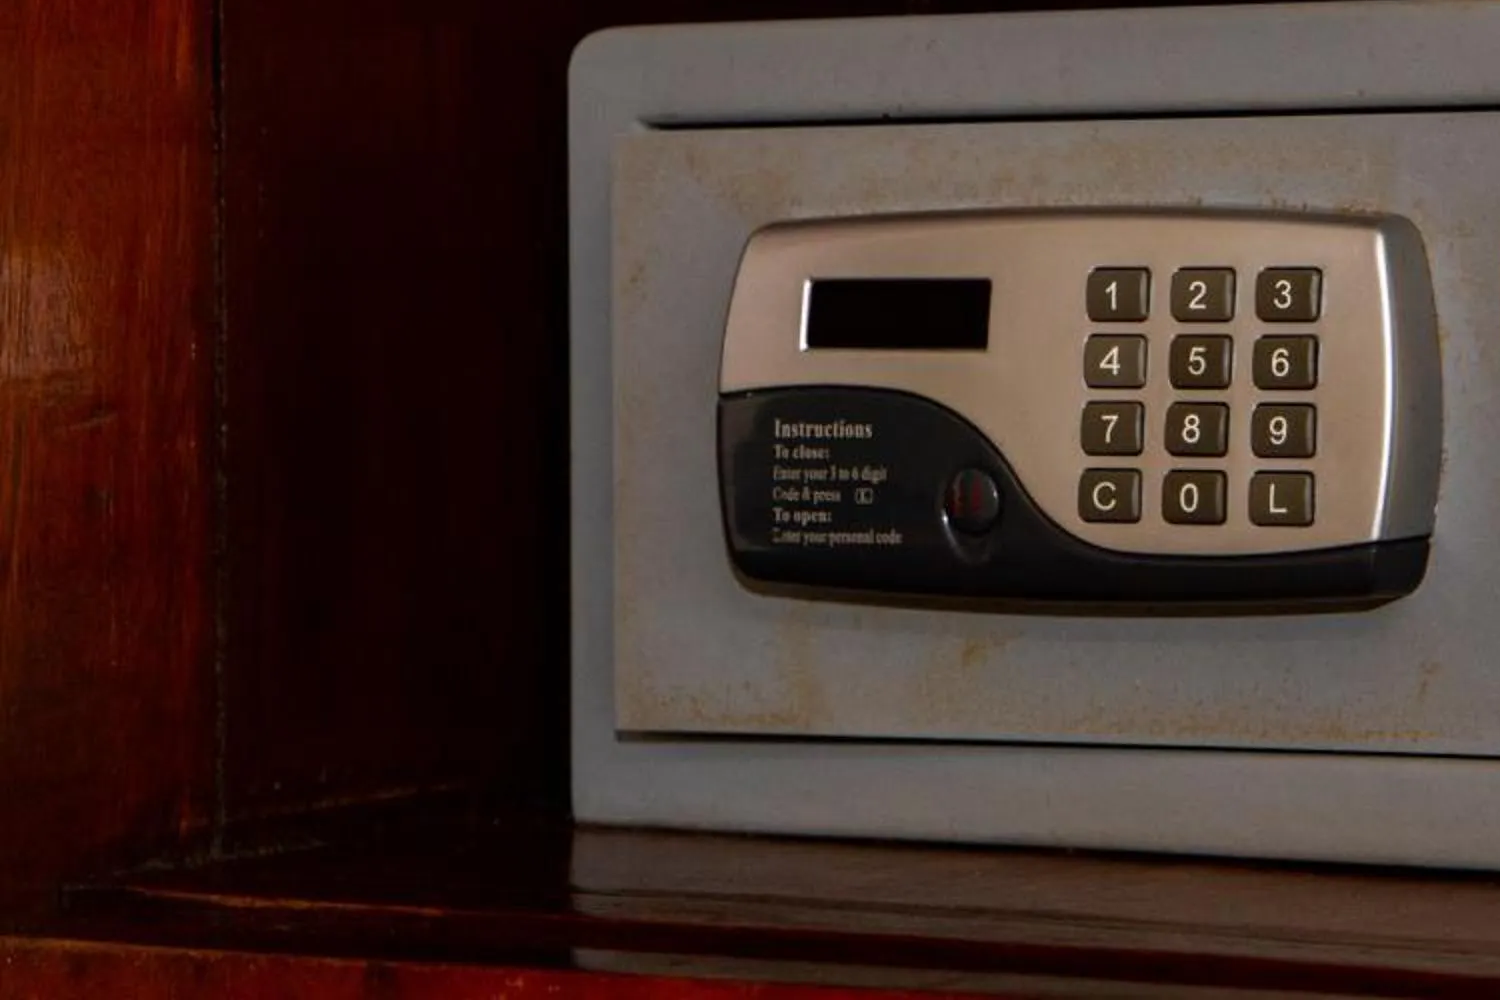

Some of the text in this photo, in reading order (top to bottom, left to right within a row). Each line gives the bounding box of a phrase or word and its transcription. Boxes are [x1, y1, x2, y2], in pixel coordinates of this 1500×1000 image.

[1105, 281, 1118, 311] 1
[1188, 281, 1207, 310] 2
[1273, 279, 1292, 309] 3
[1099, 346, 1121, 376] 4
[1187, 347, 1207, 375] 5
[1270, 348, 1290, 377] 6
[773, 418, 873, 439] Instructions
[1101, 415, 1119, 444] 7
[1181, 414, 1201, 444] 8
[1269, 416, 1288, 445] 9
[773, 443, 831, 460] To close:
[772, 465, 801, 481] Enter
[803, 467, 828, 484] your
[838, 467, 850, 481] to
[861, 465, 888, 485] digit
[772, 486, 800, 502] Code
[813, 490, 842, 505] press
[1092, 482, 1117, 511] C
[1179, 483, 1199, 513] 0
[1268, 483, 1288, 513] L
[772, 507, 832, 526] To open:
[803, 530, 827, 546] your
[828, 528, 874, 547] personal
[876, 528, 903, 545] code
